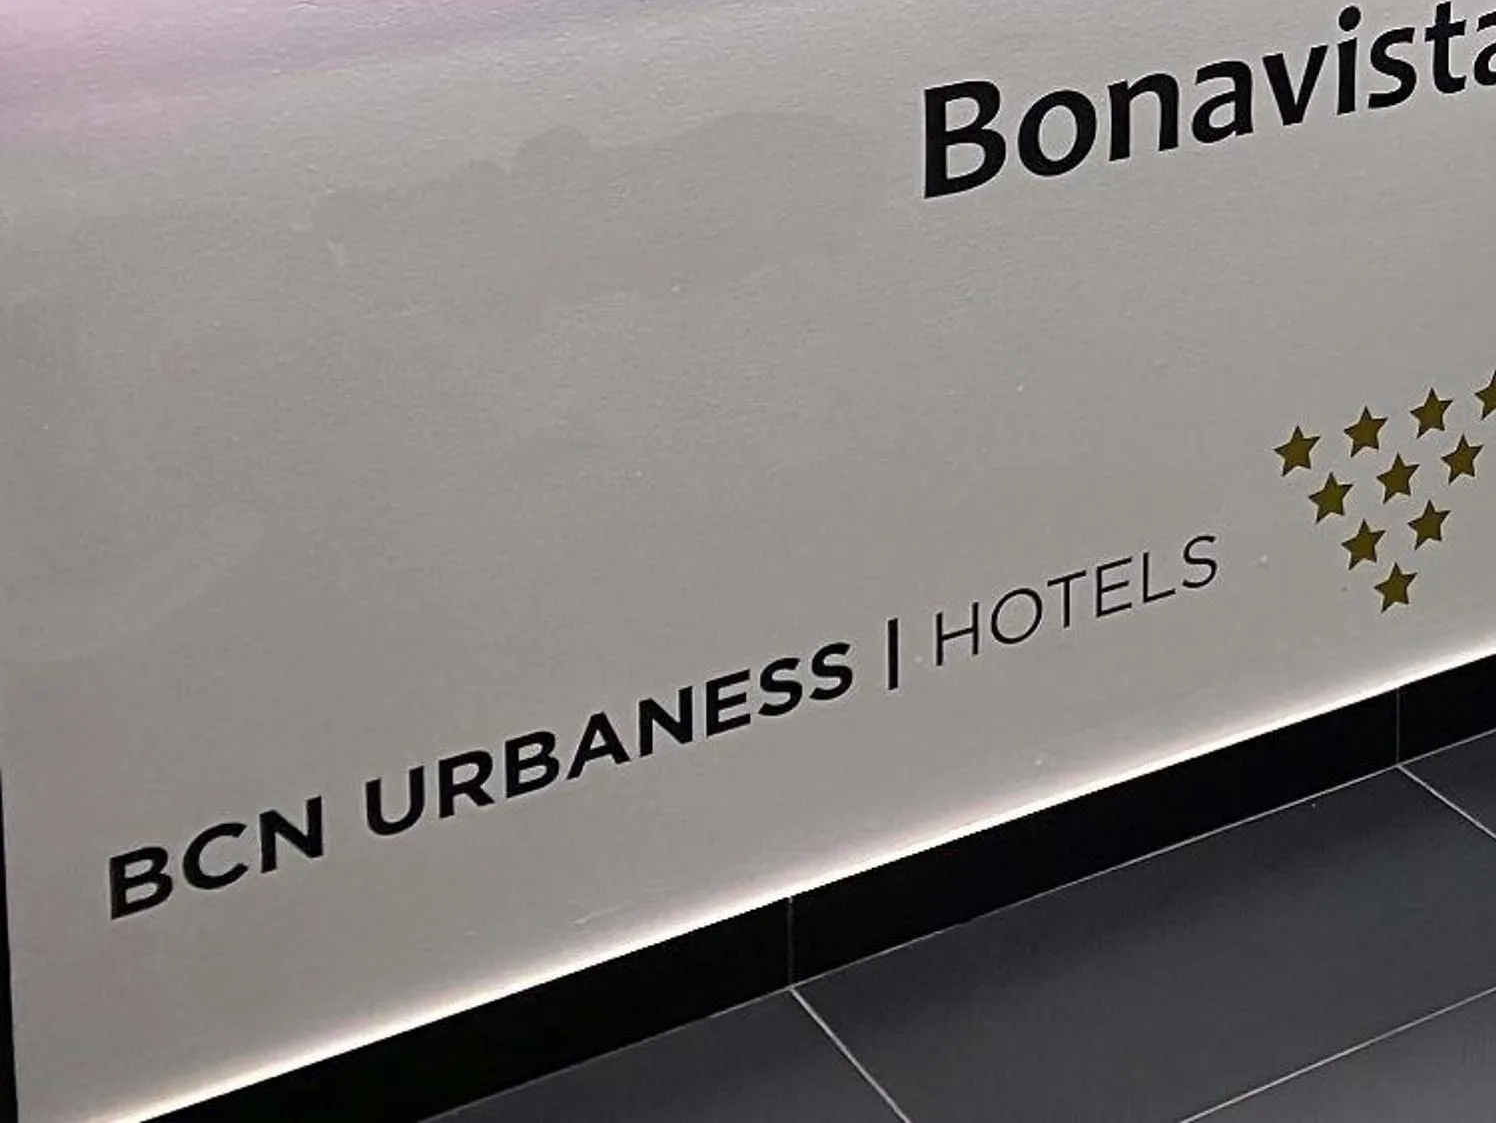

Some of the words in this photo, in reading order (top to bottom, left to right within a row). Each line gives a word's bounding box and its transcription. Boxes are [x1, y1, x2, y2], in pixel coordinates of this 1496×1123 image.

[108, 795, 325, 921] BCN
[365, 641, 854, 836] URBANESS
[934, 534, 1220, 668] HOTELS
